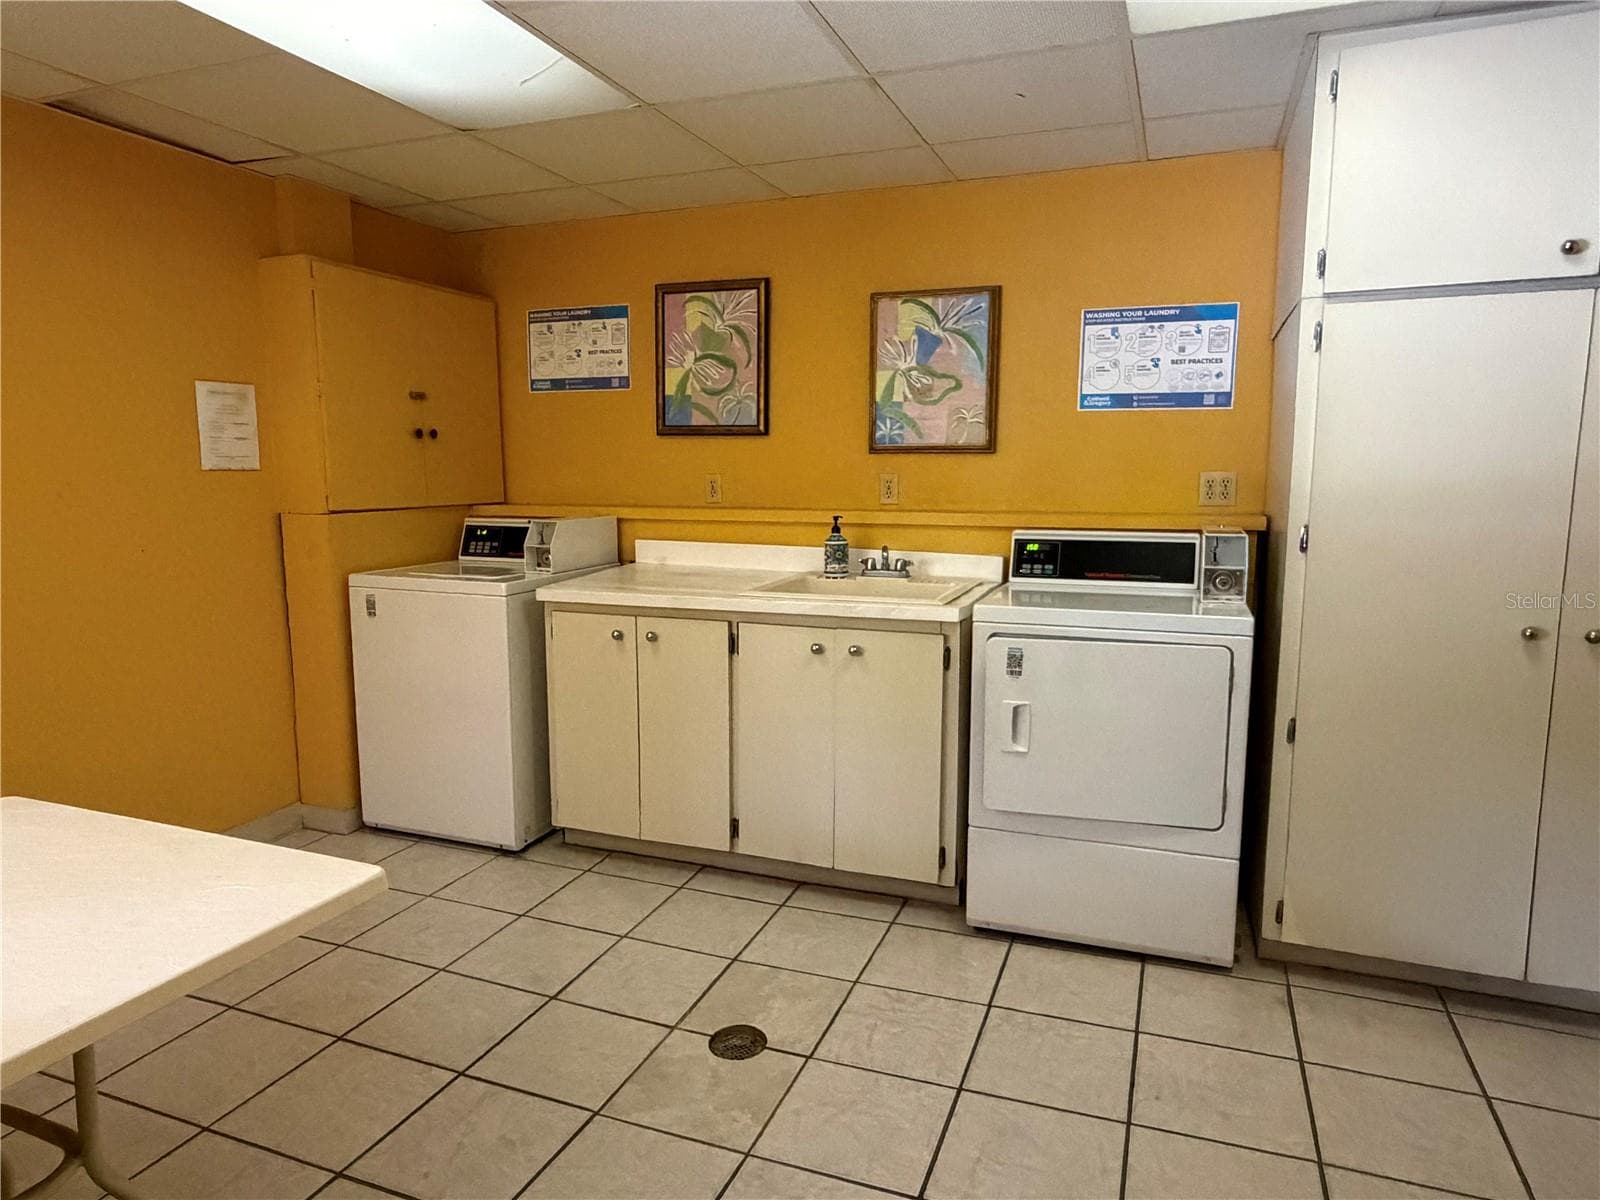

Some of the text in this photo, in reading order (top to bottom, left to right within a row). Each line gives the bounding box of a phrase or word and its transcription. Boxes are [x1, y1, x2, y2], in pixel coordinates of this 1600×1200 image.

[1085, 311, 1120, 319] WASHING
[1125, 332, 1137, 353] 2
[1165, 330, 1177, 351] 3
[1188, 357, 1223, 365] PRACTICES
